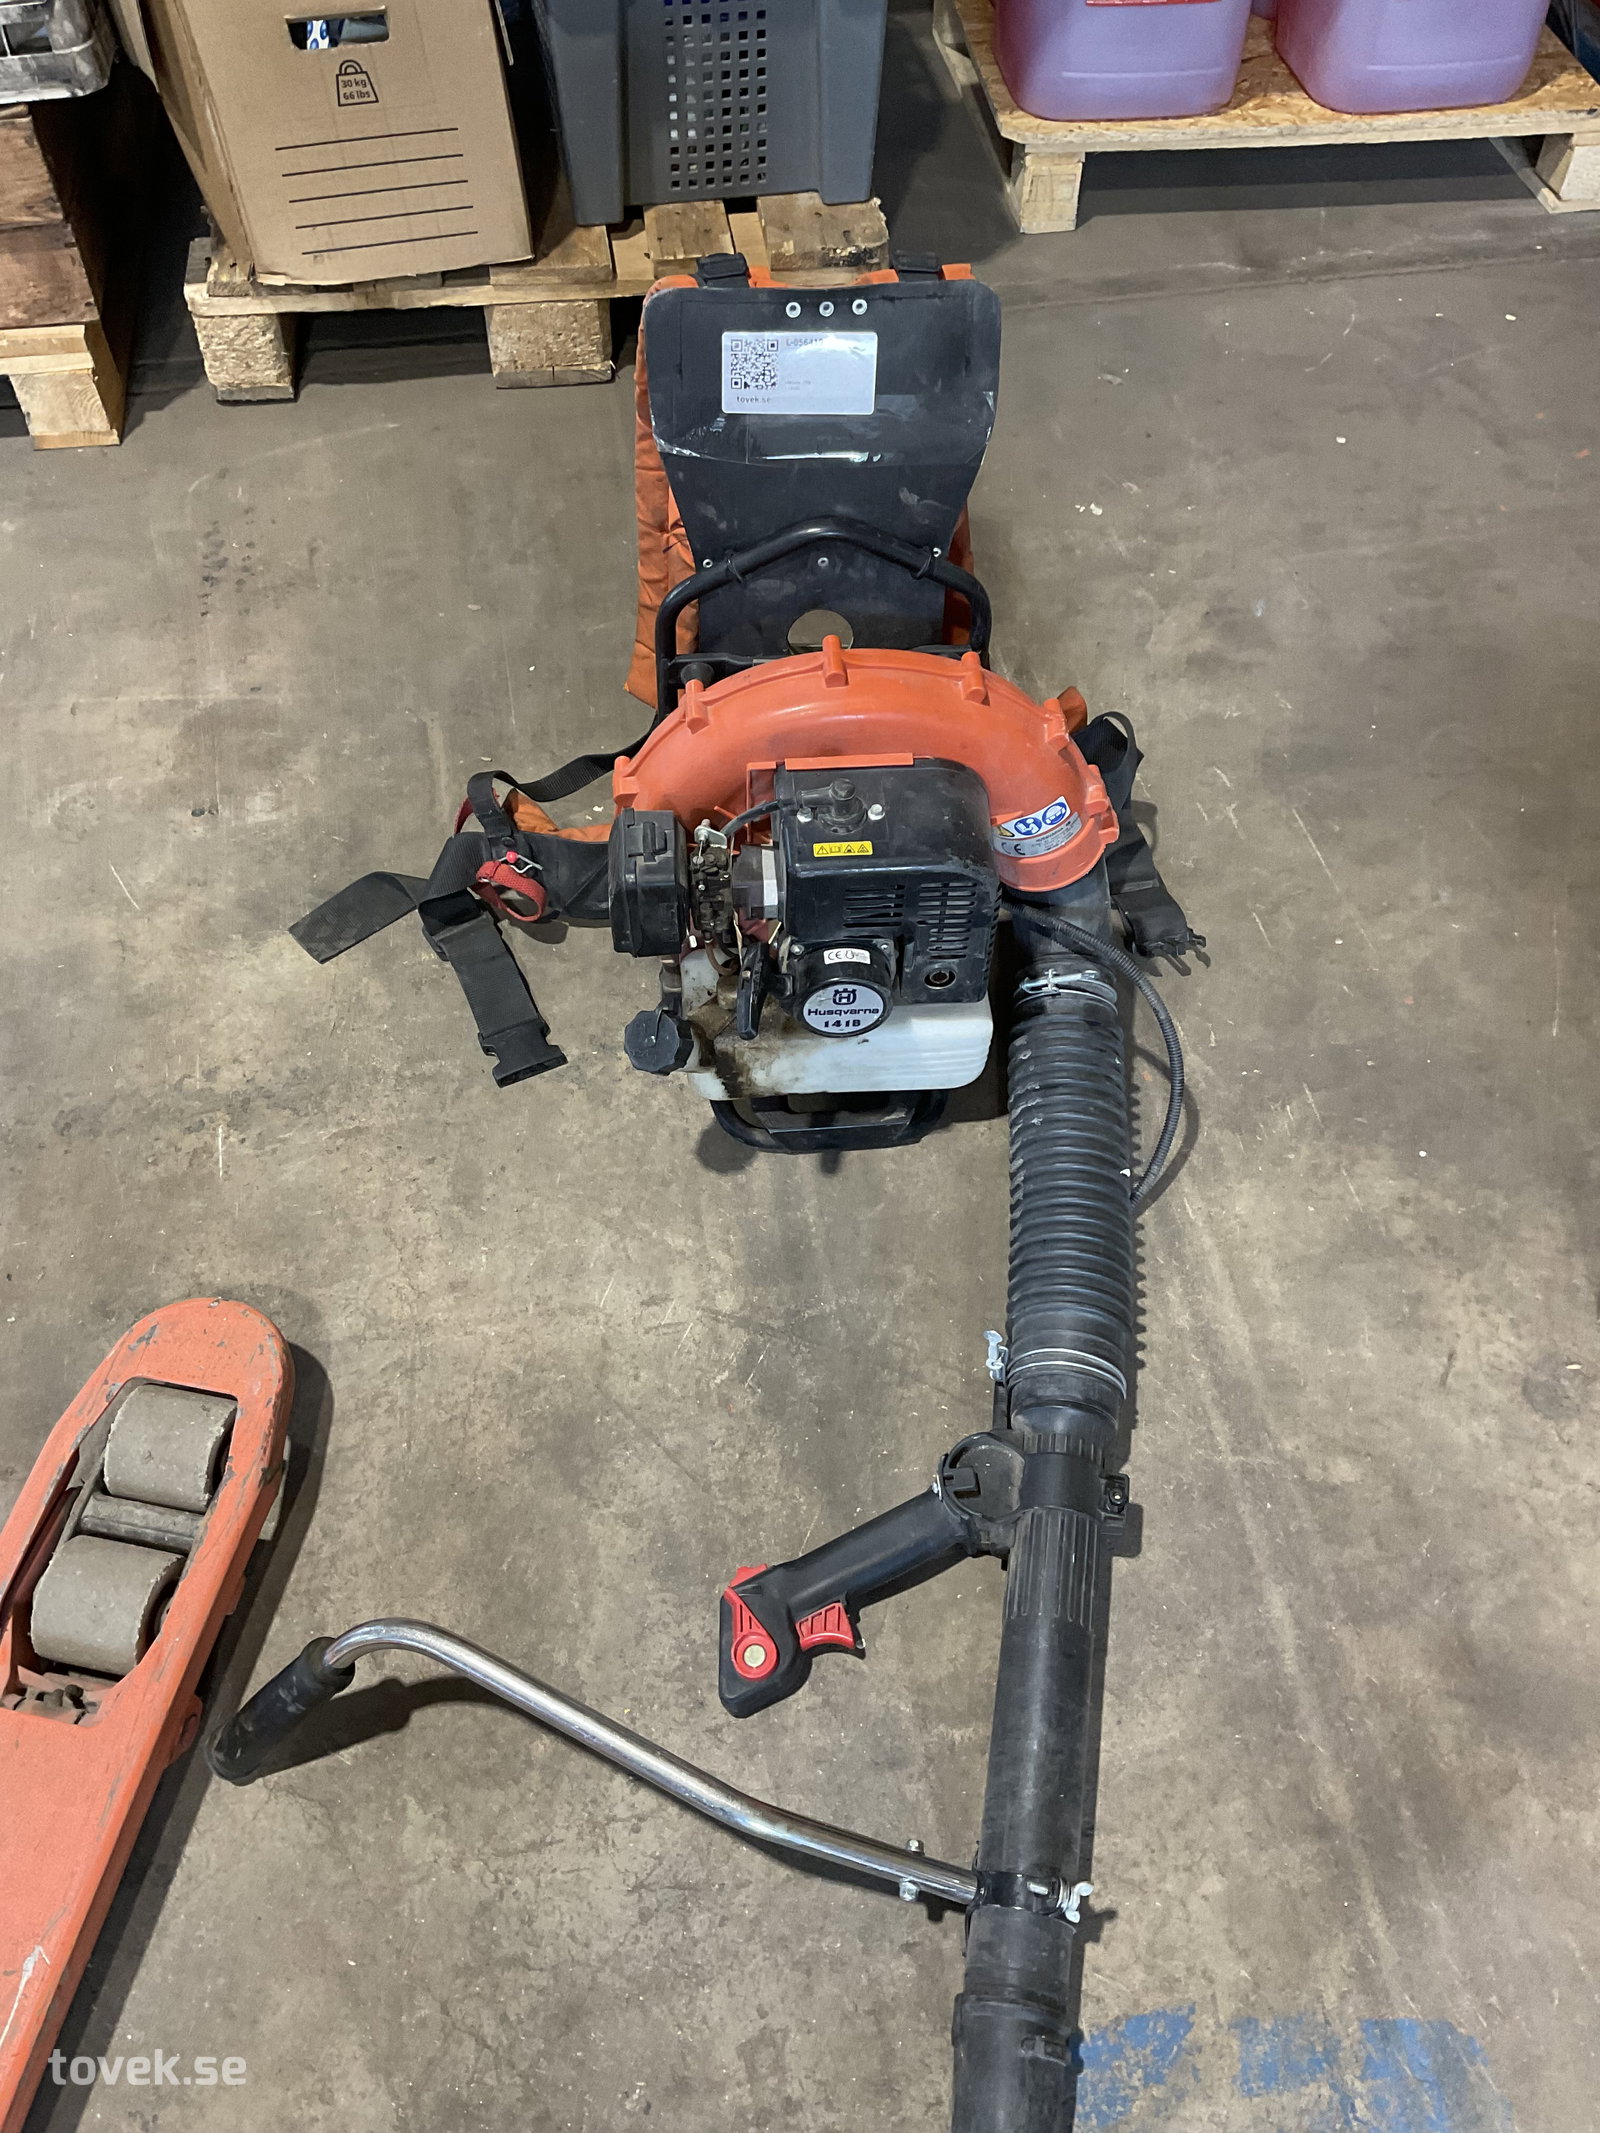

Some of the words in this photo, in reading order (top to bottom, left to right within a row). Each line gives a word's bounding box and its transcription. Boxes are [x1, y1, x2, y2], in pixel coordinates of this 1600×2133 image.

[341, 79, 353, 89] 30
[354, 78, 367, 89] kg
[343, 91, 355, 100] 66
[356, 90, 371, 99] lbs
[807, 1008, 880, 1017] Husqvarna
